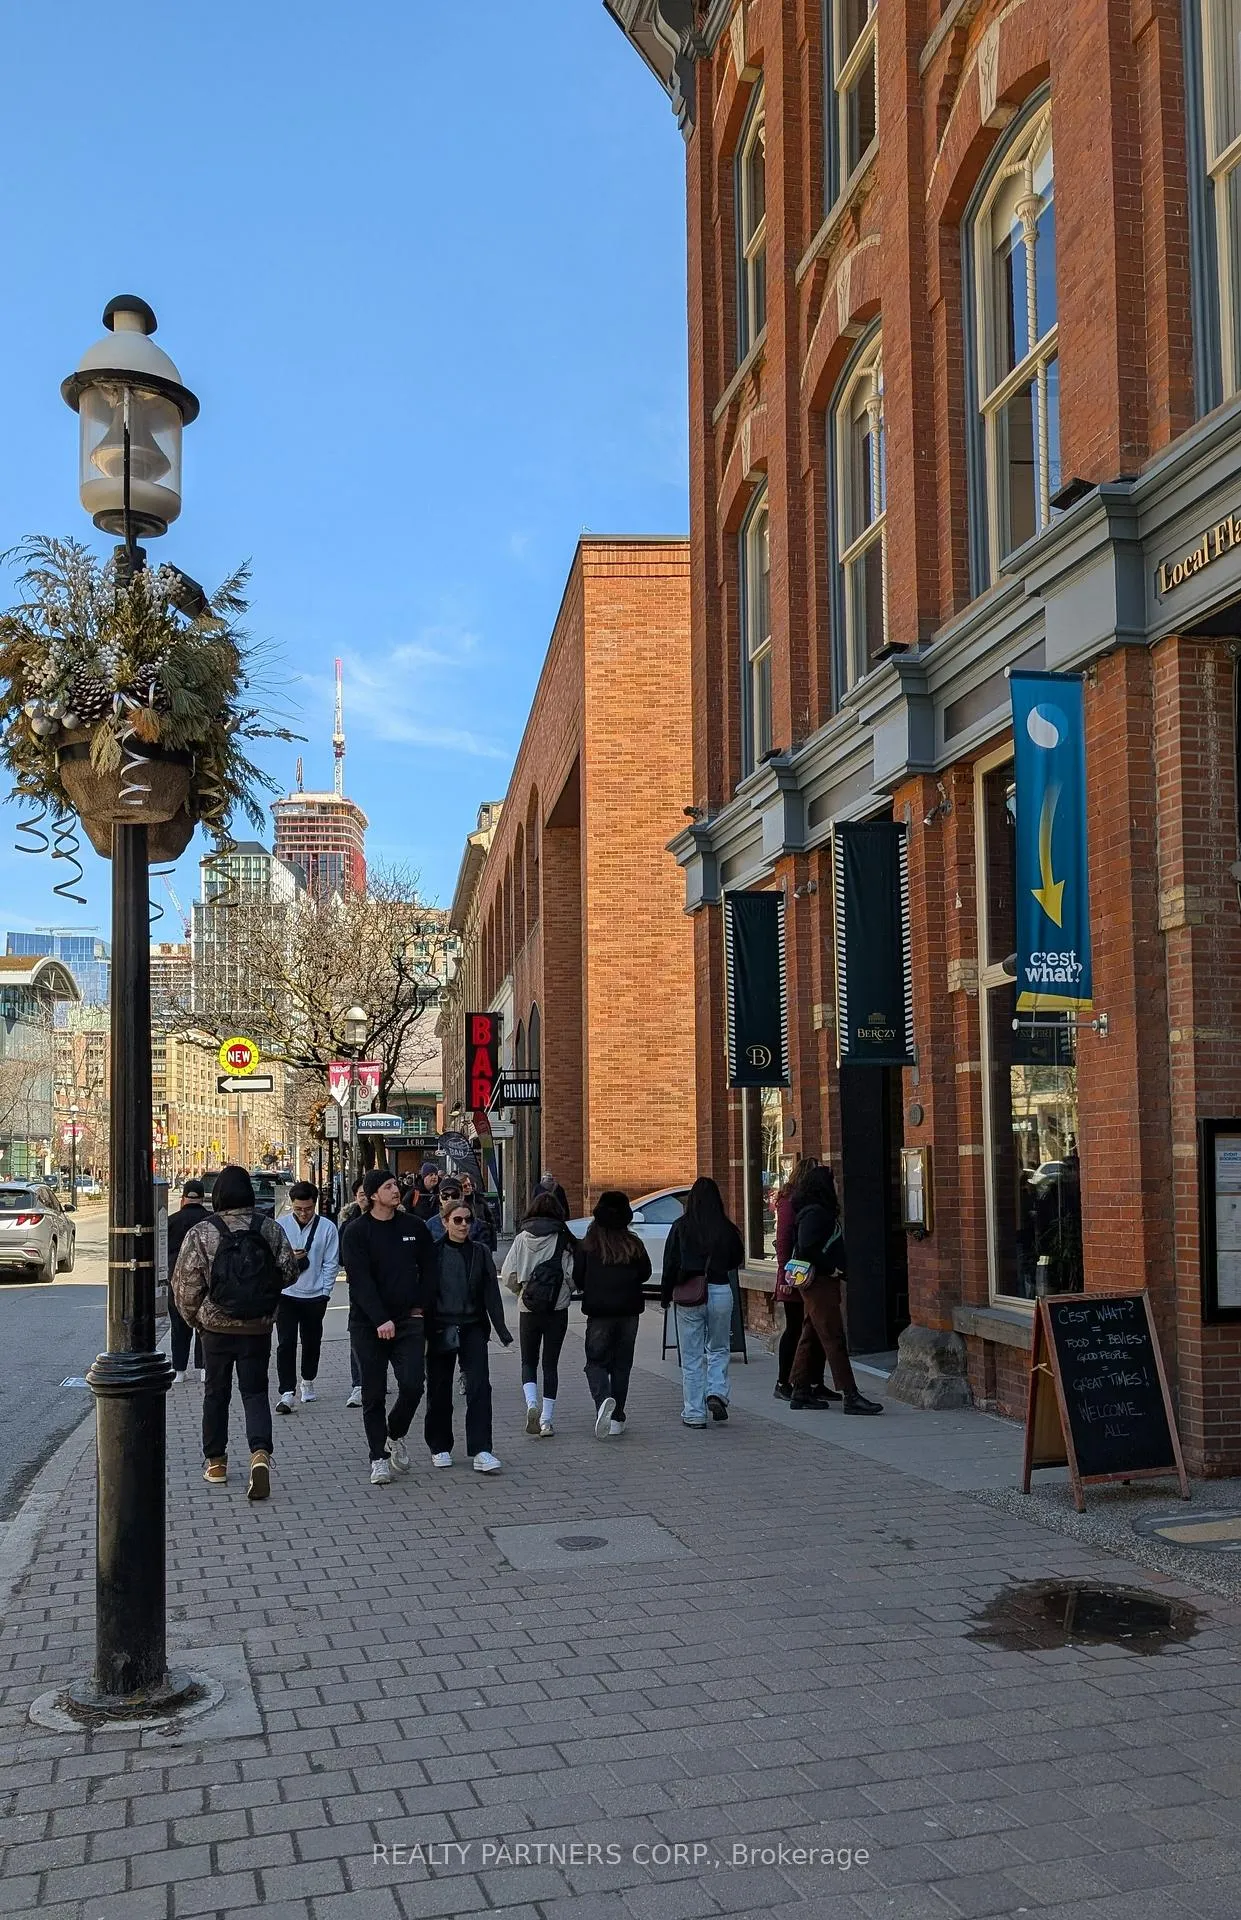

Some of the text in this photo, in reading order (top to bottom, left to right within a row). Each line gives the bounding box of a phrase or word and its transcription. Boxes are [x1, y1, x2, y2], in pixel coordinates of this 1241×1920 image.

[1160, 532, 1210, 594] Local
[1024, 962, 1083, 983] what?
[857, 1028, 897, 1040] BERCZY
[227, 1050, 251, 1063] NEW
[472, 1015, 493, 1108] BAR
[358, 1119, 391, 1128] Farquhars
